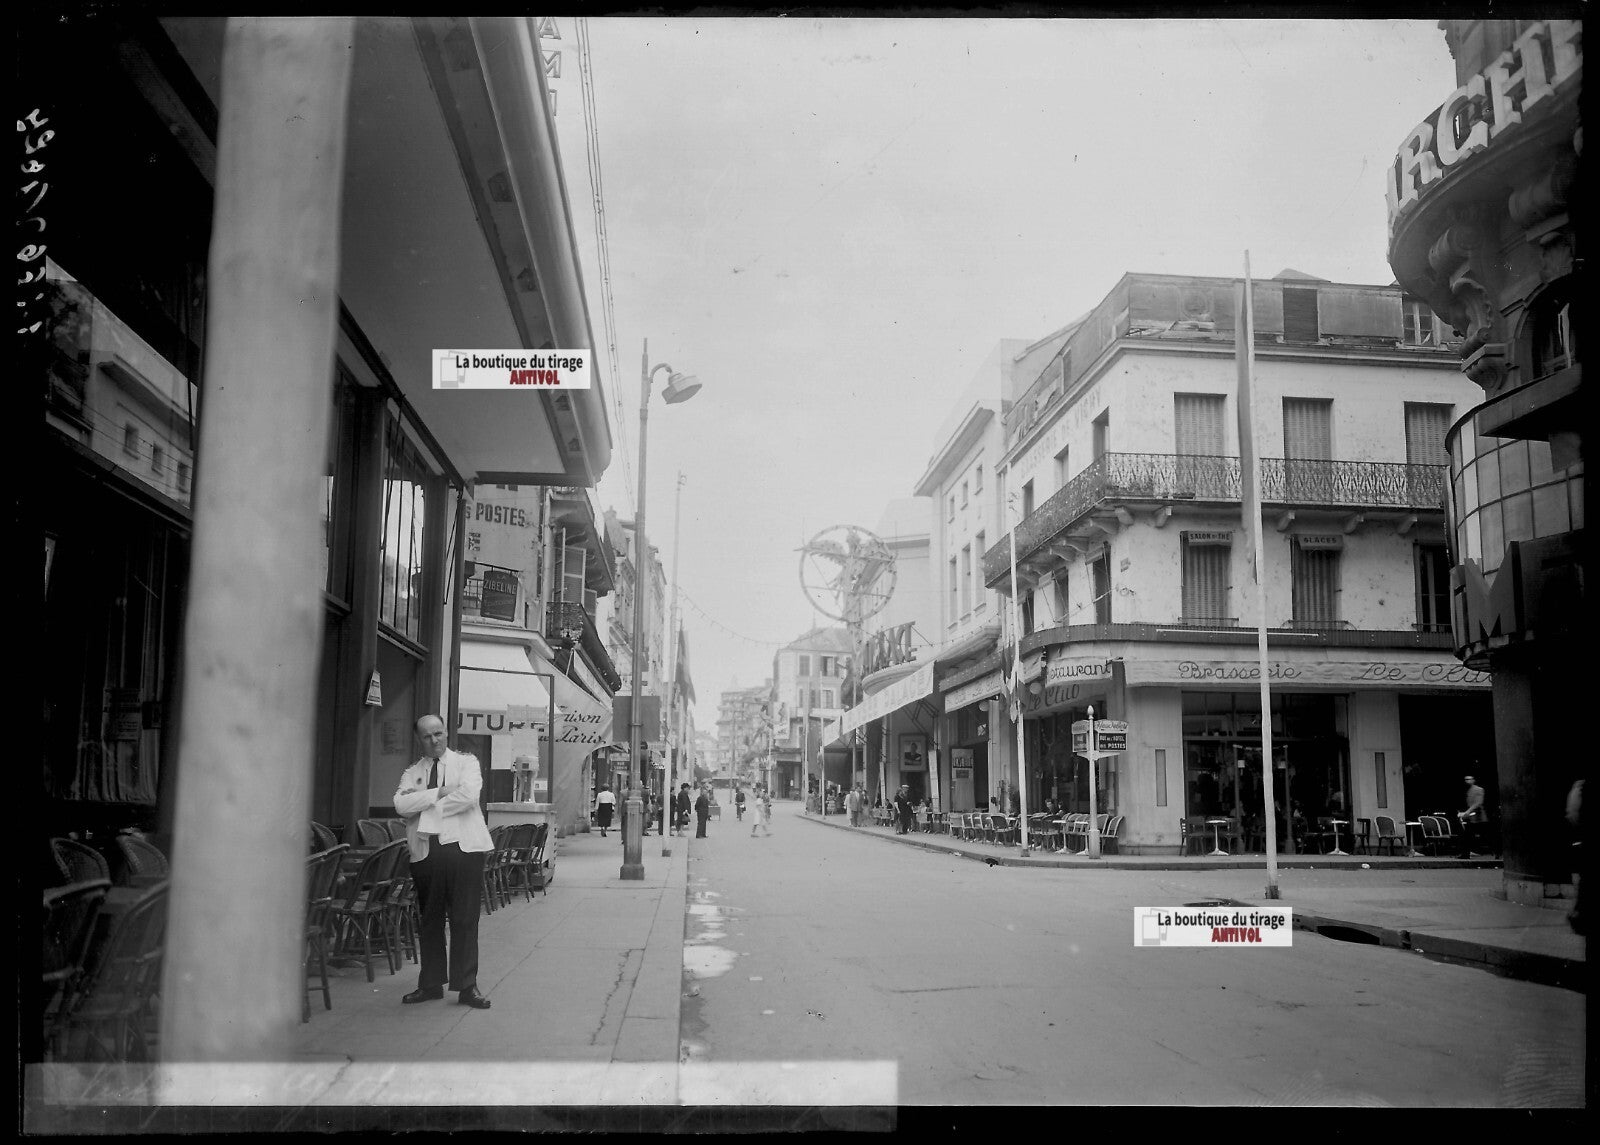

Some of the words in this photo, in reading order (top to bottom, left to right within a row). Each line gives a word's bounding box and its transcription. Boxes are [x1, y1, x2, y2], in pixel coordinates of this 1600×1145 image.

[475, 502, 526, 527] POSTES
[483, 579, 518, 595] ZIBELINE
[1351, 662, 1406, 682] Le
[1422, 663, 1492, 684] Clu
[555, 725, 608, 744] Paris
